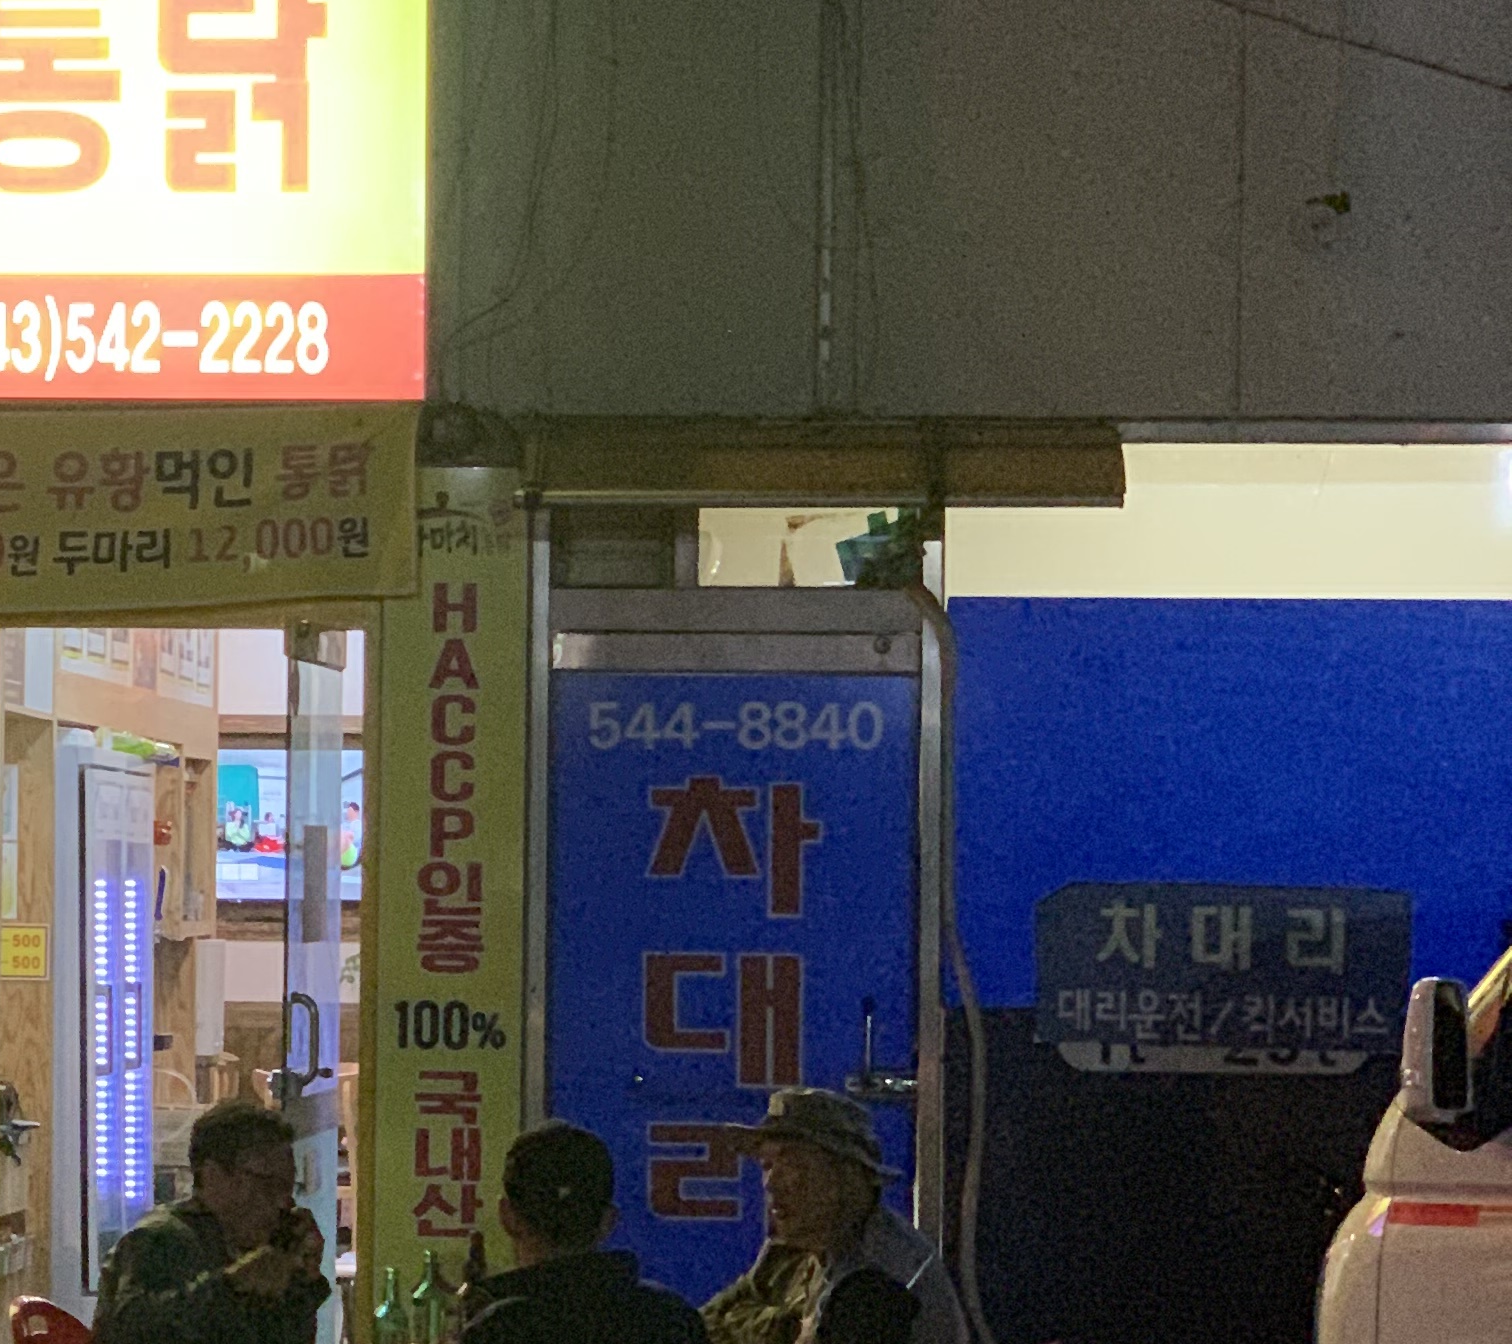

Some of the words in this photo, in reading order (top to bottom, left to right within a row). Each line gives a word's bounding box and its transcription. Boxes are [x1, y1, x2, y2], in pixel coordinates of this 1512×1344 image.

[52, 527, 171, 576] 두마리
[588, 701, 884, 750] 544-8840
[415, 581, 485, 975] HACCP인증
[12, 934, 41, 948] 500
[12, 956, 41, 969] 500
[393, 1000, 507, 1052] 100%
[411, 1069, 484, 1241] 국내산
